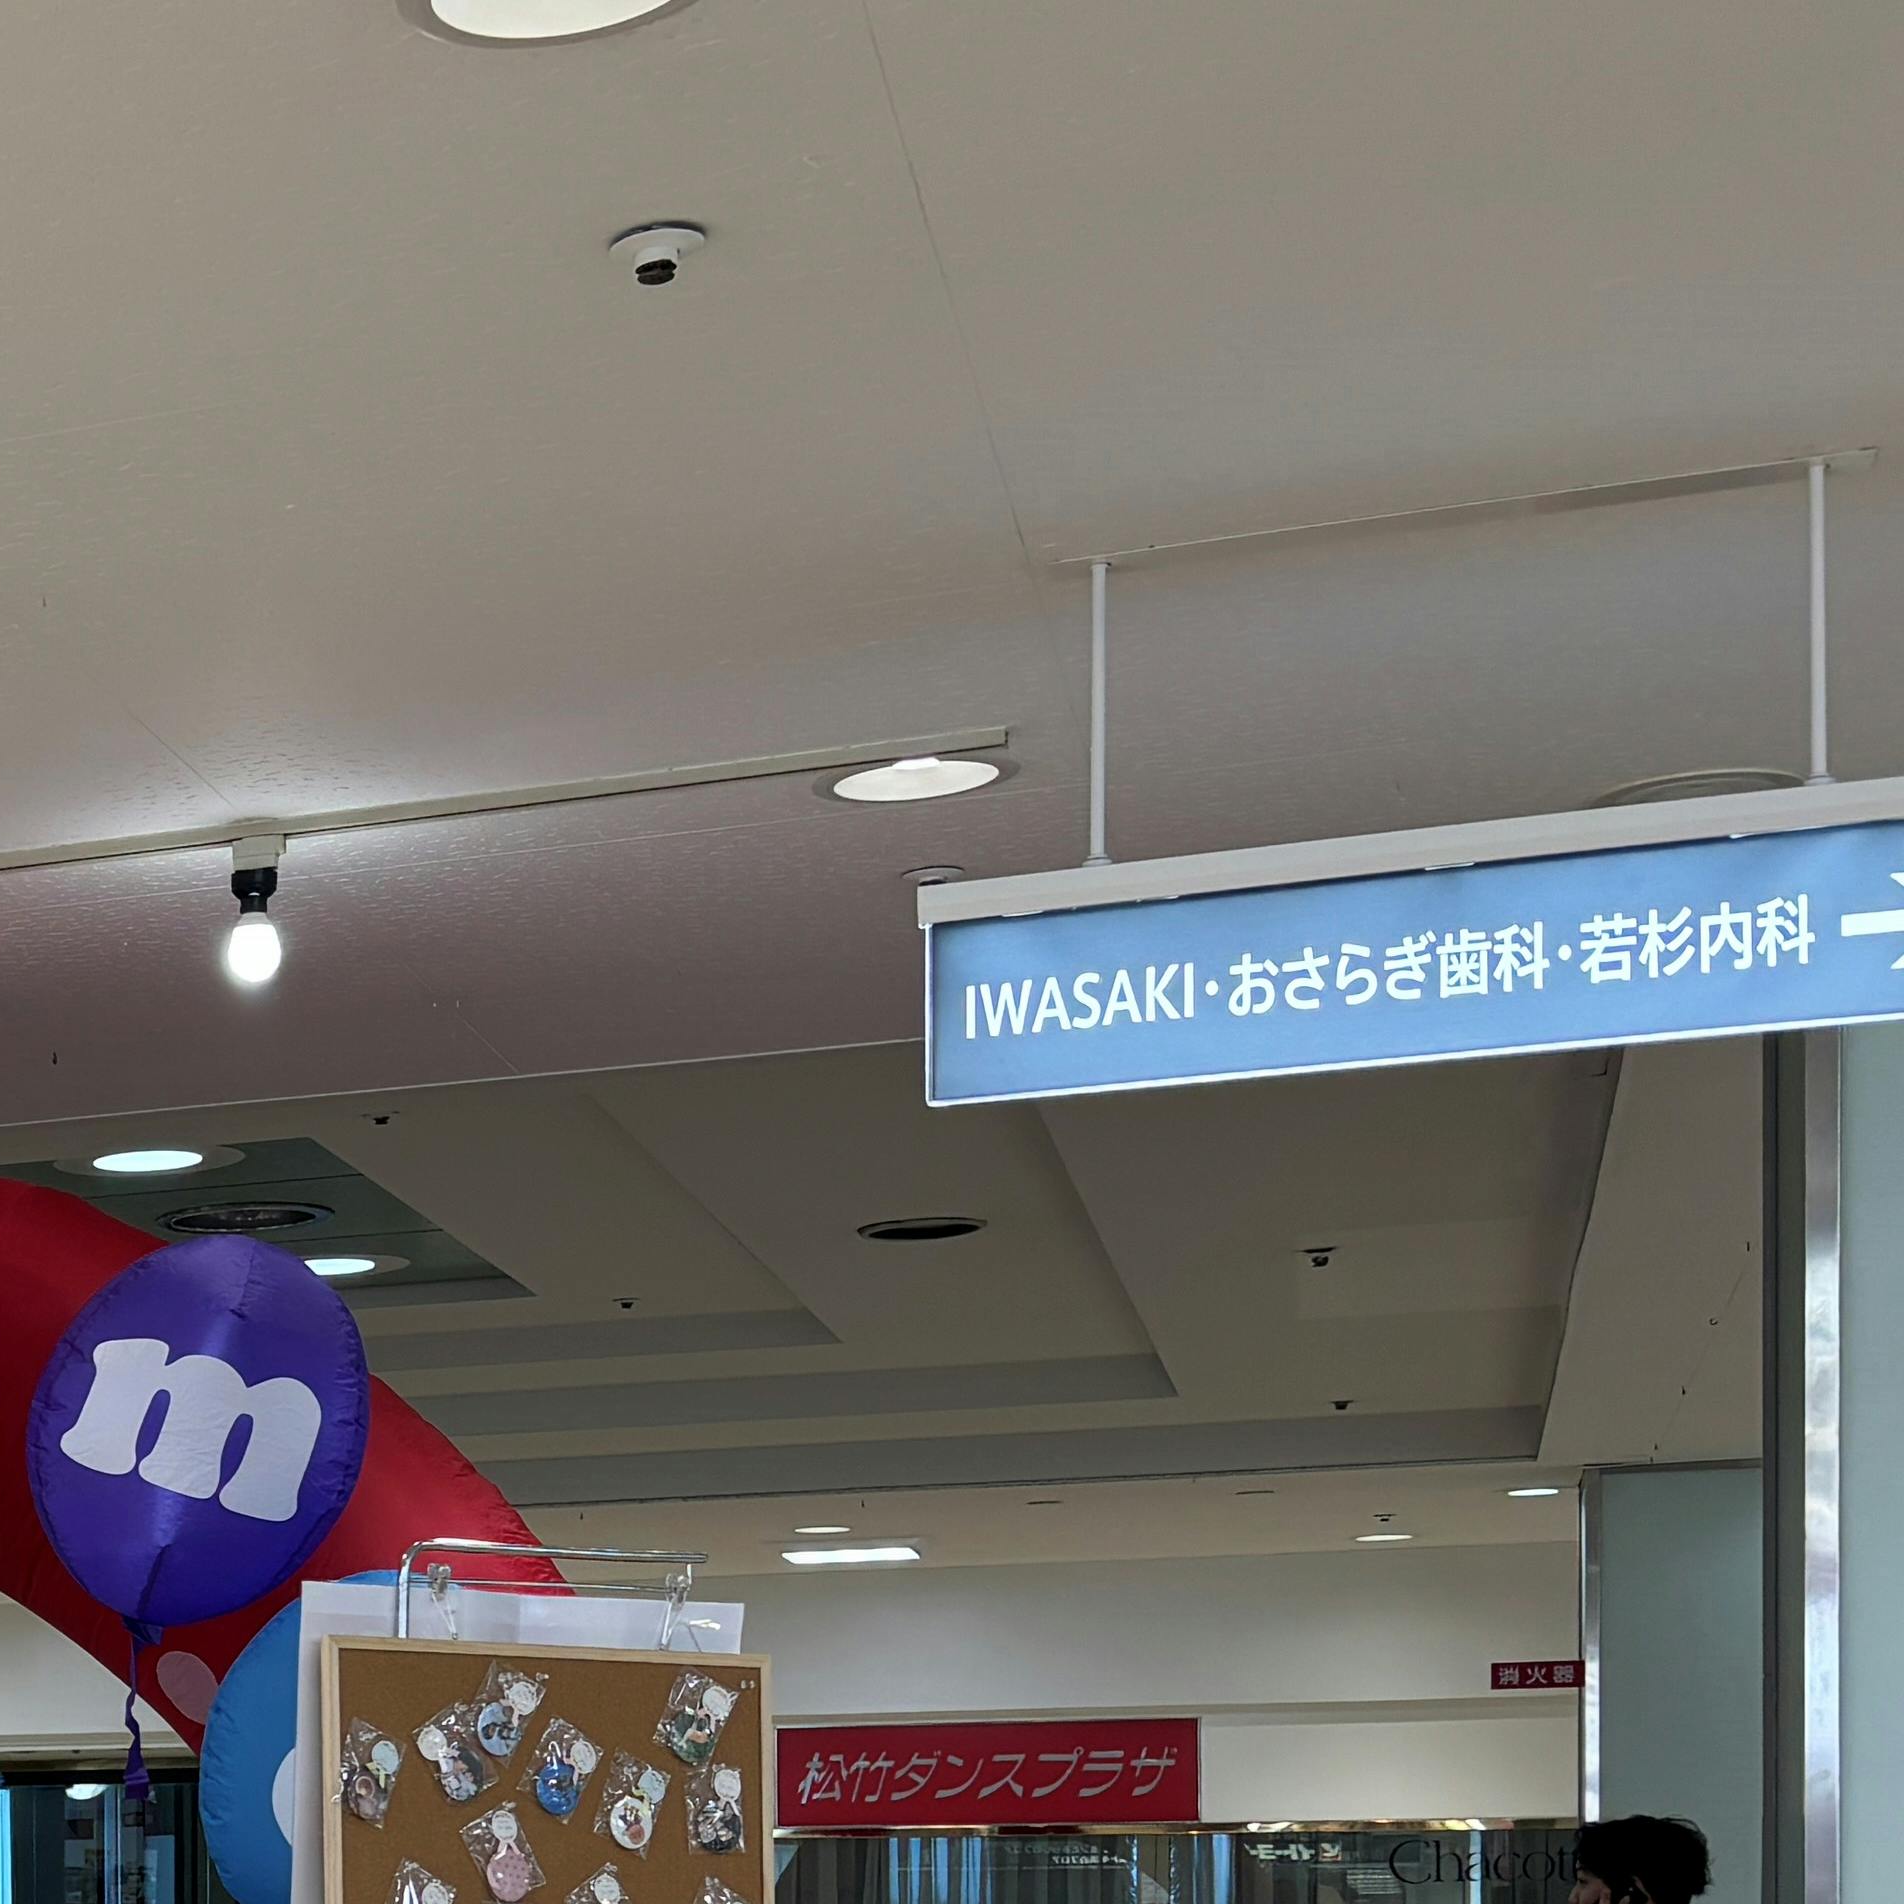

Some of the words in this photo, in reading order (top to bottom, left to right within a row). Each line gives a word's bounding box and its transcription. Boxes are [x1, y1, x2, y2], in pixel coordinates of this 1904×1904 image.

[1498, 1665, 1575, 1685] 消火器
[798, 1746, 1178, 1805] 松竹ダンスプラザ
